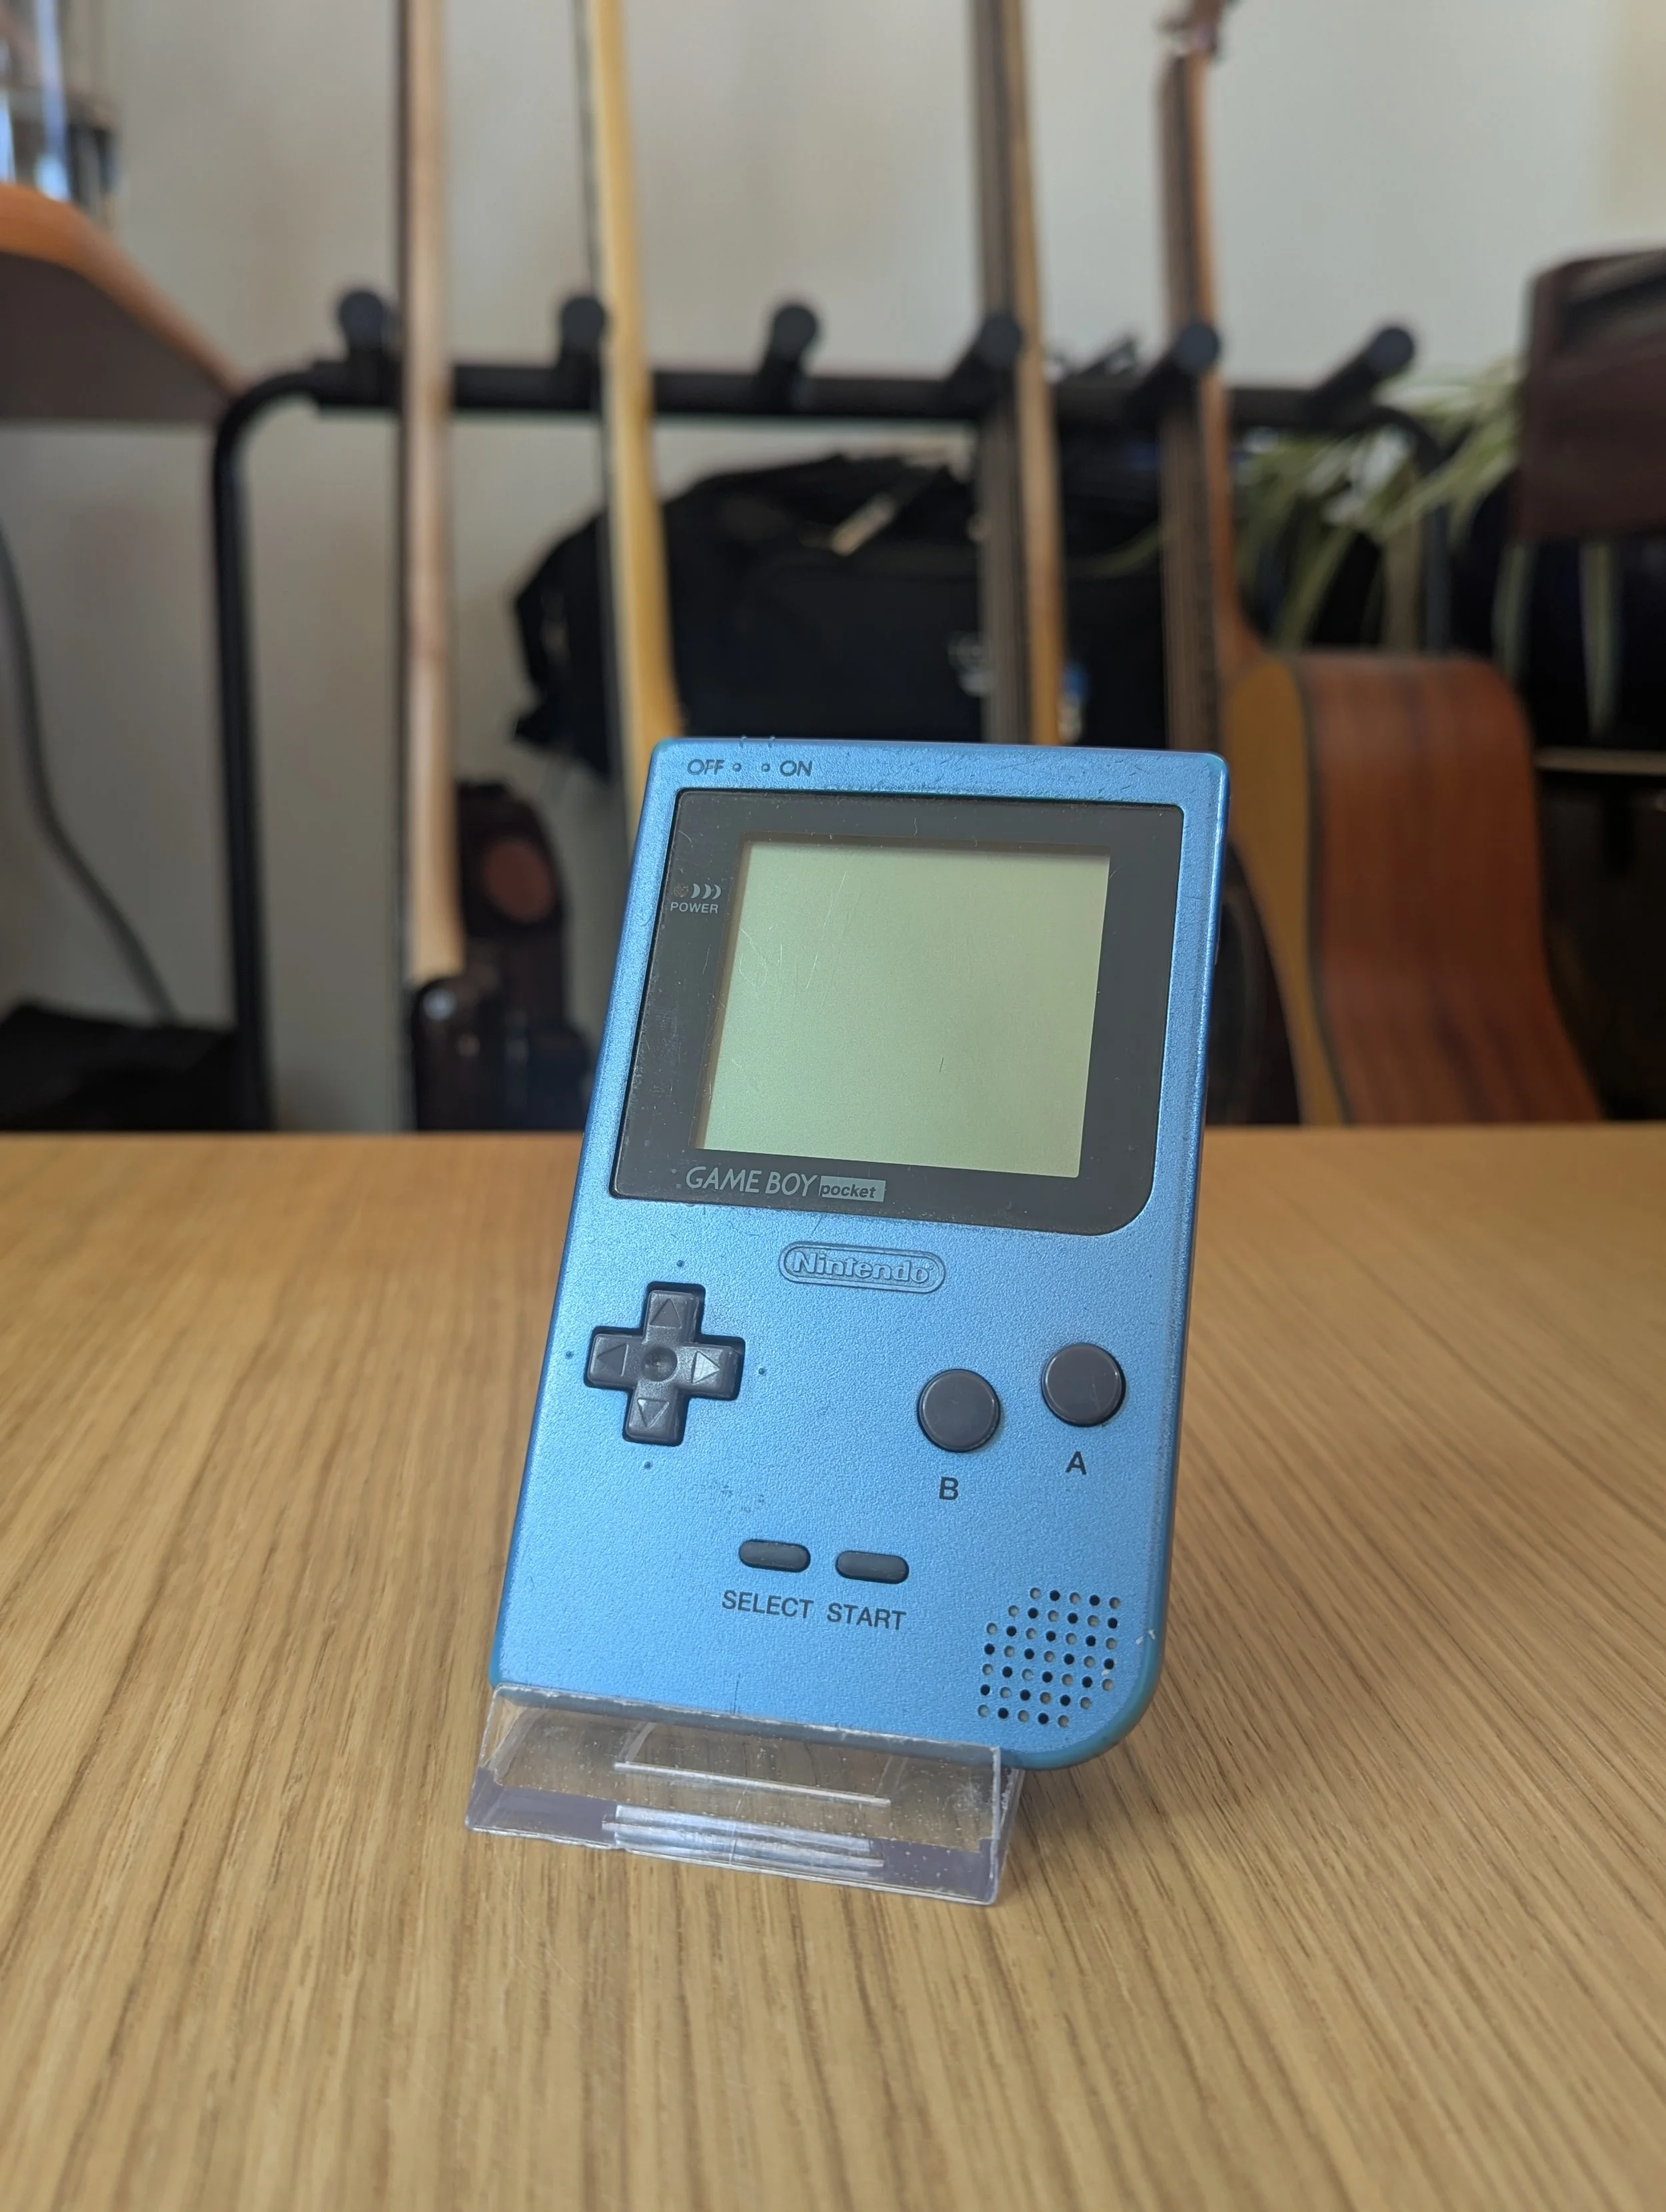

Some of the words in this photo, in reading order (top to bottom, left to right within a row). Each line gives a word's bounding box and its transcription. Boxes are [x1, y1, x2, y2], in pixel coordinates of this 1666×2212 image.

[687, 759, 724, 775] OFF
[779, 760, 813, 776] ON
[670, 901, 718, 913] POWER
[686, 1166, 762, 1193] GAME
[765, 1171, 818, 1197] BOY
[820, 1183, 876, 1199] pocket
[792, 1251, 932, 1284] Nintendo
[1066, 1451, 1087, 1474] A
[938, 1476, 960, 1500] B
[722, 1590, 814, 1619] SELECT
[826, 1602, 906, 1630] START
